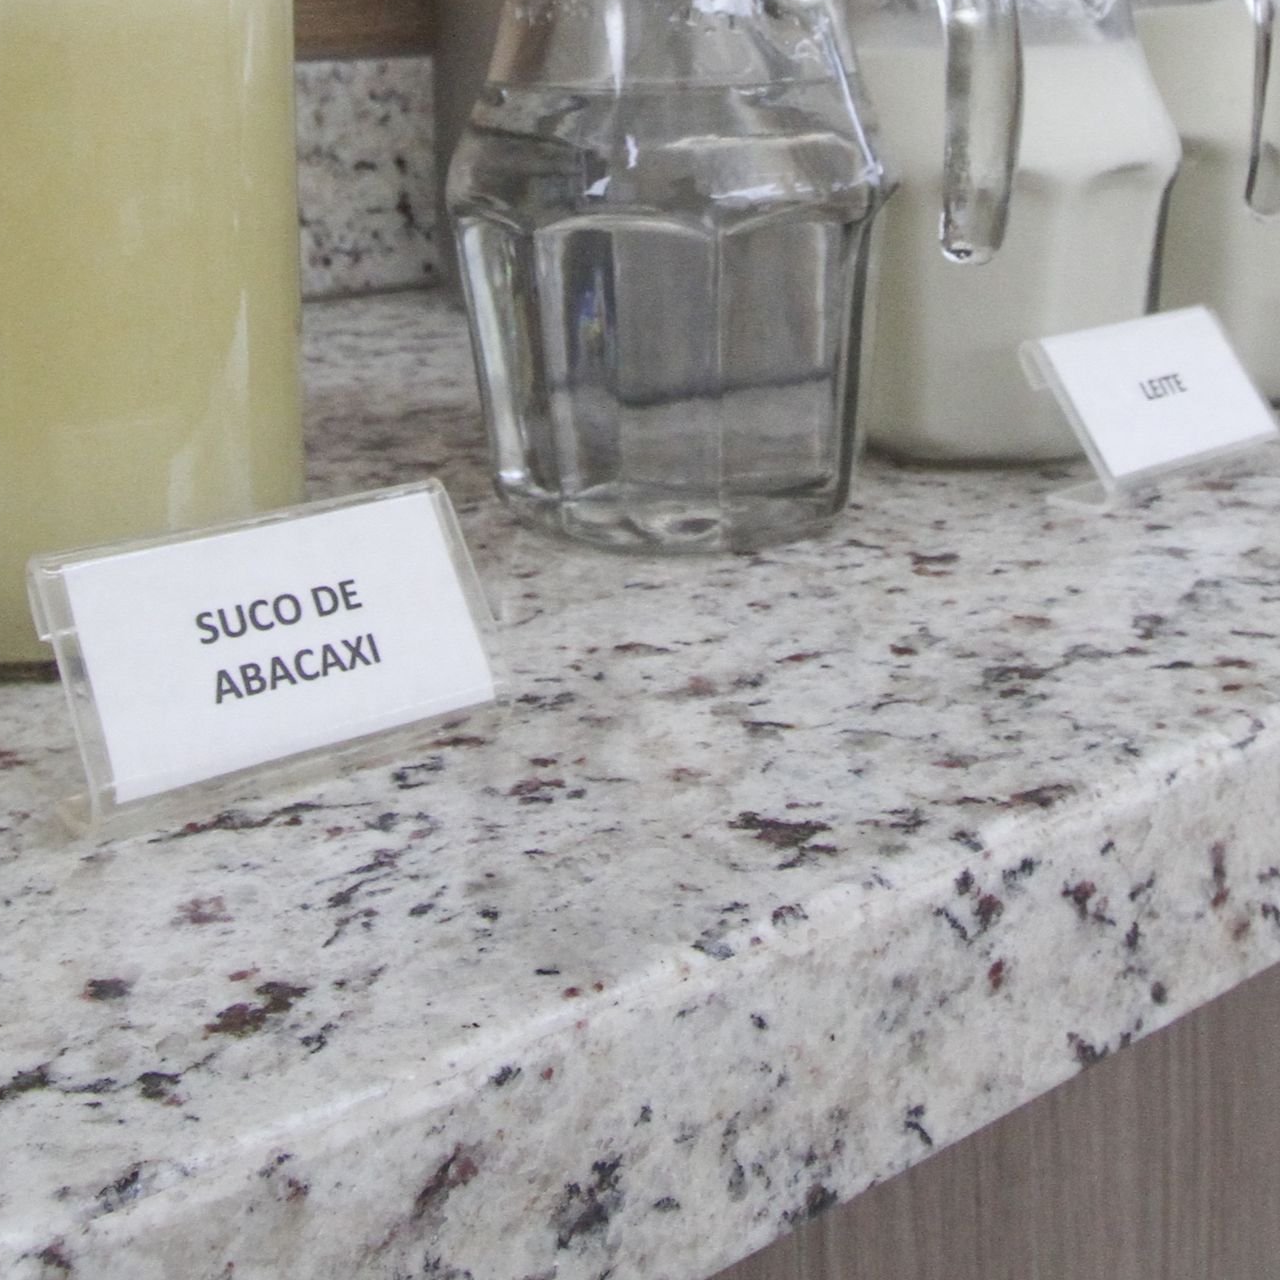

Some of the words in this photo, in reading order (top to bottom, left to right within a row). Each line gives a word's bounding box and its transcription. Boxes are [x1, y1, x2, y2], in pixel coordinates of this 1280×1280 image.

[1139, 372, 1187, 401] LEITE
[195, 593, 302, 645] SUCO
[310, 579, 363, 618] DE
[215, 633, 382, 705] ABACAXI
